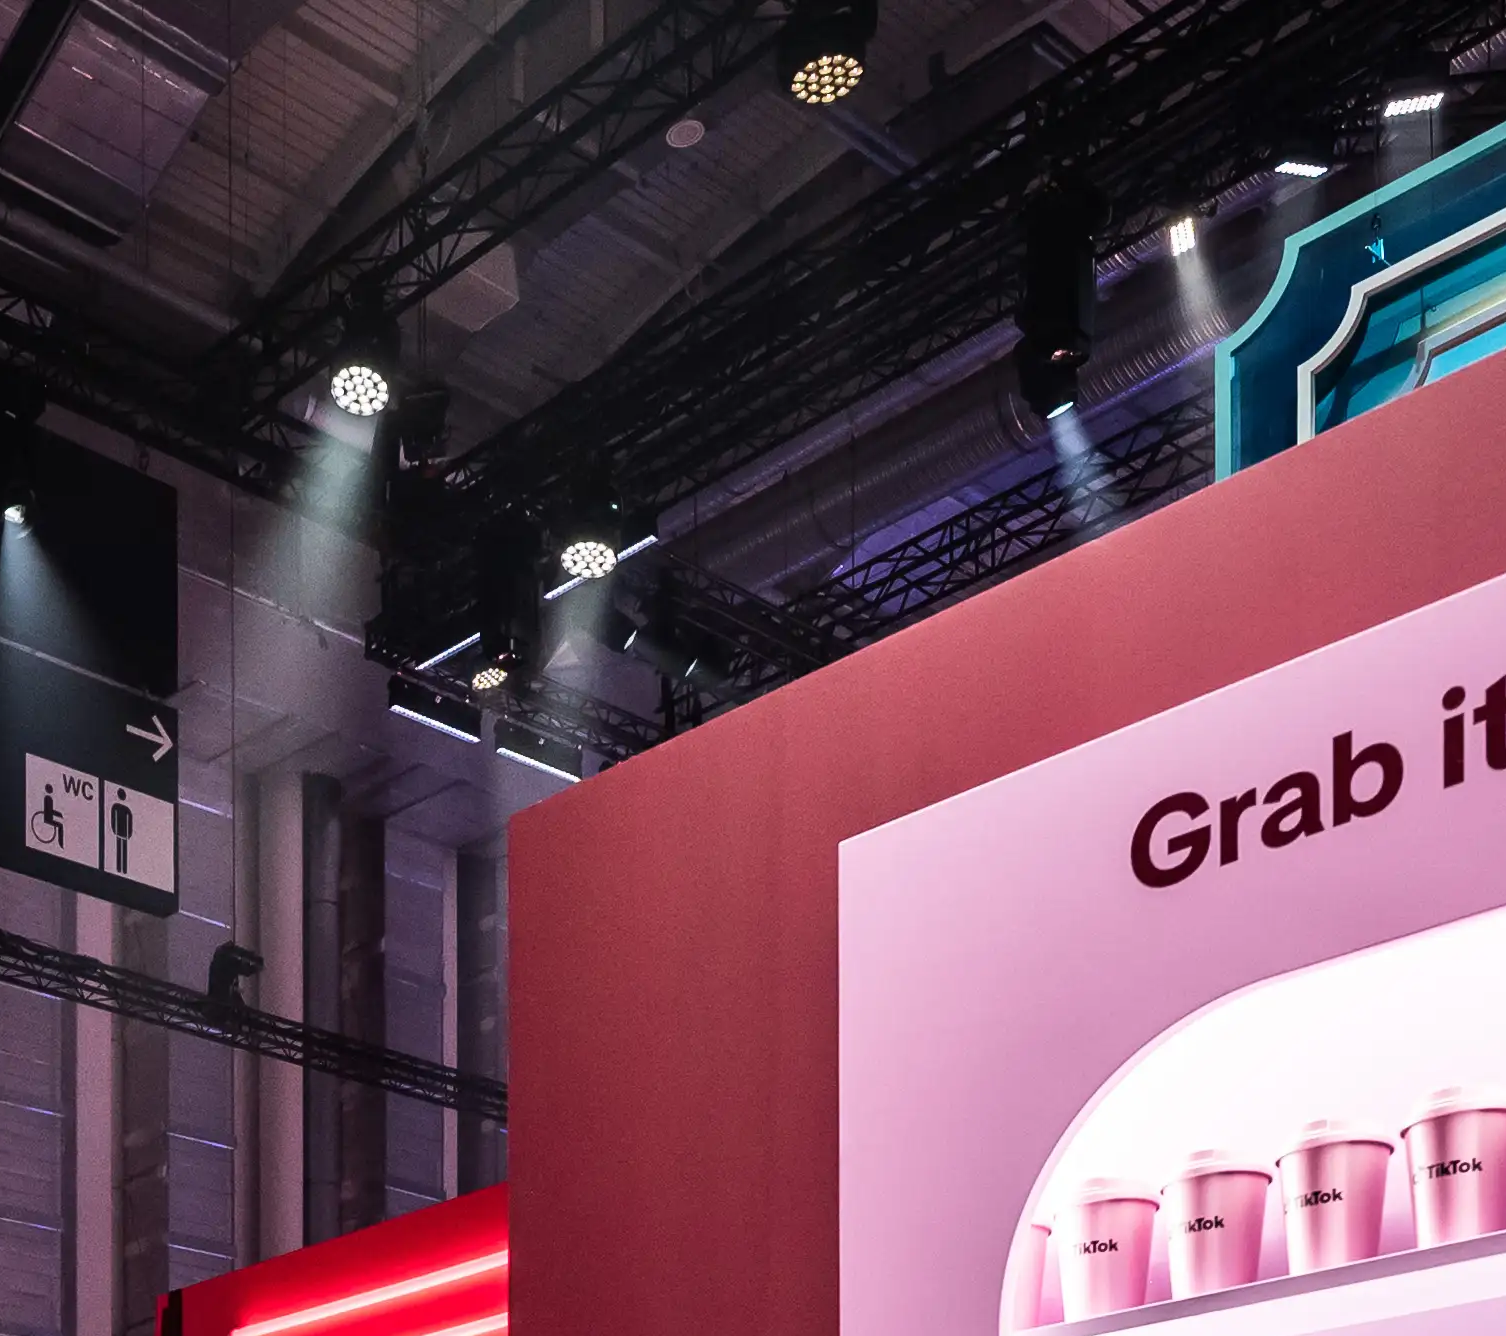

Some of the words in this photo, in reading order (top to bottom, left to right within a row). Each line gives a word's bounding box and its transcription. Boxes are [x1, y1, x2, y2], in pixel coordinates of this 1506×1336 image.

[60, 772, 95, 803] WC
[1128, 728, 1406, 892] Grab
[1426, 1157, 1483, 1180] TikTok
